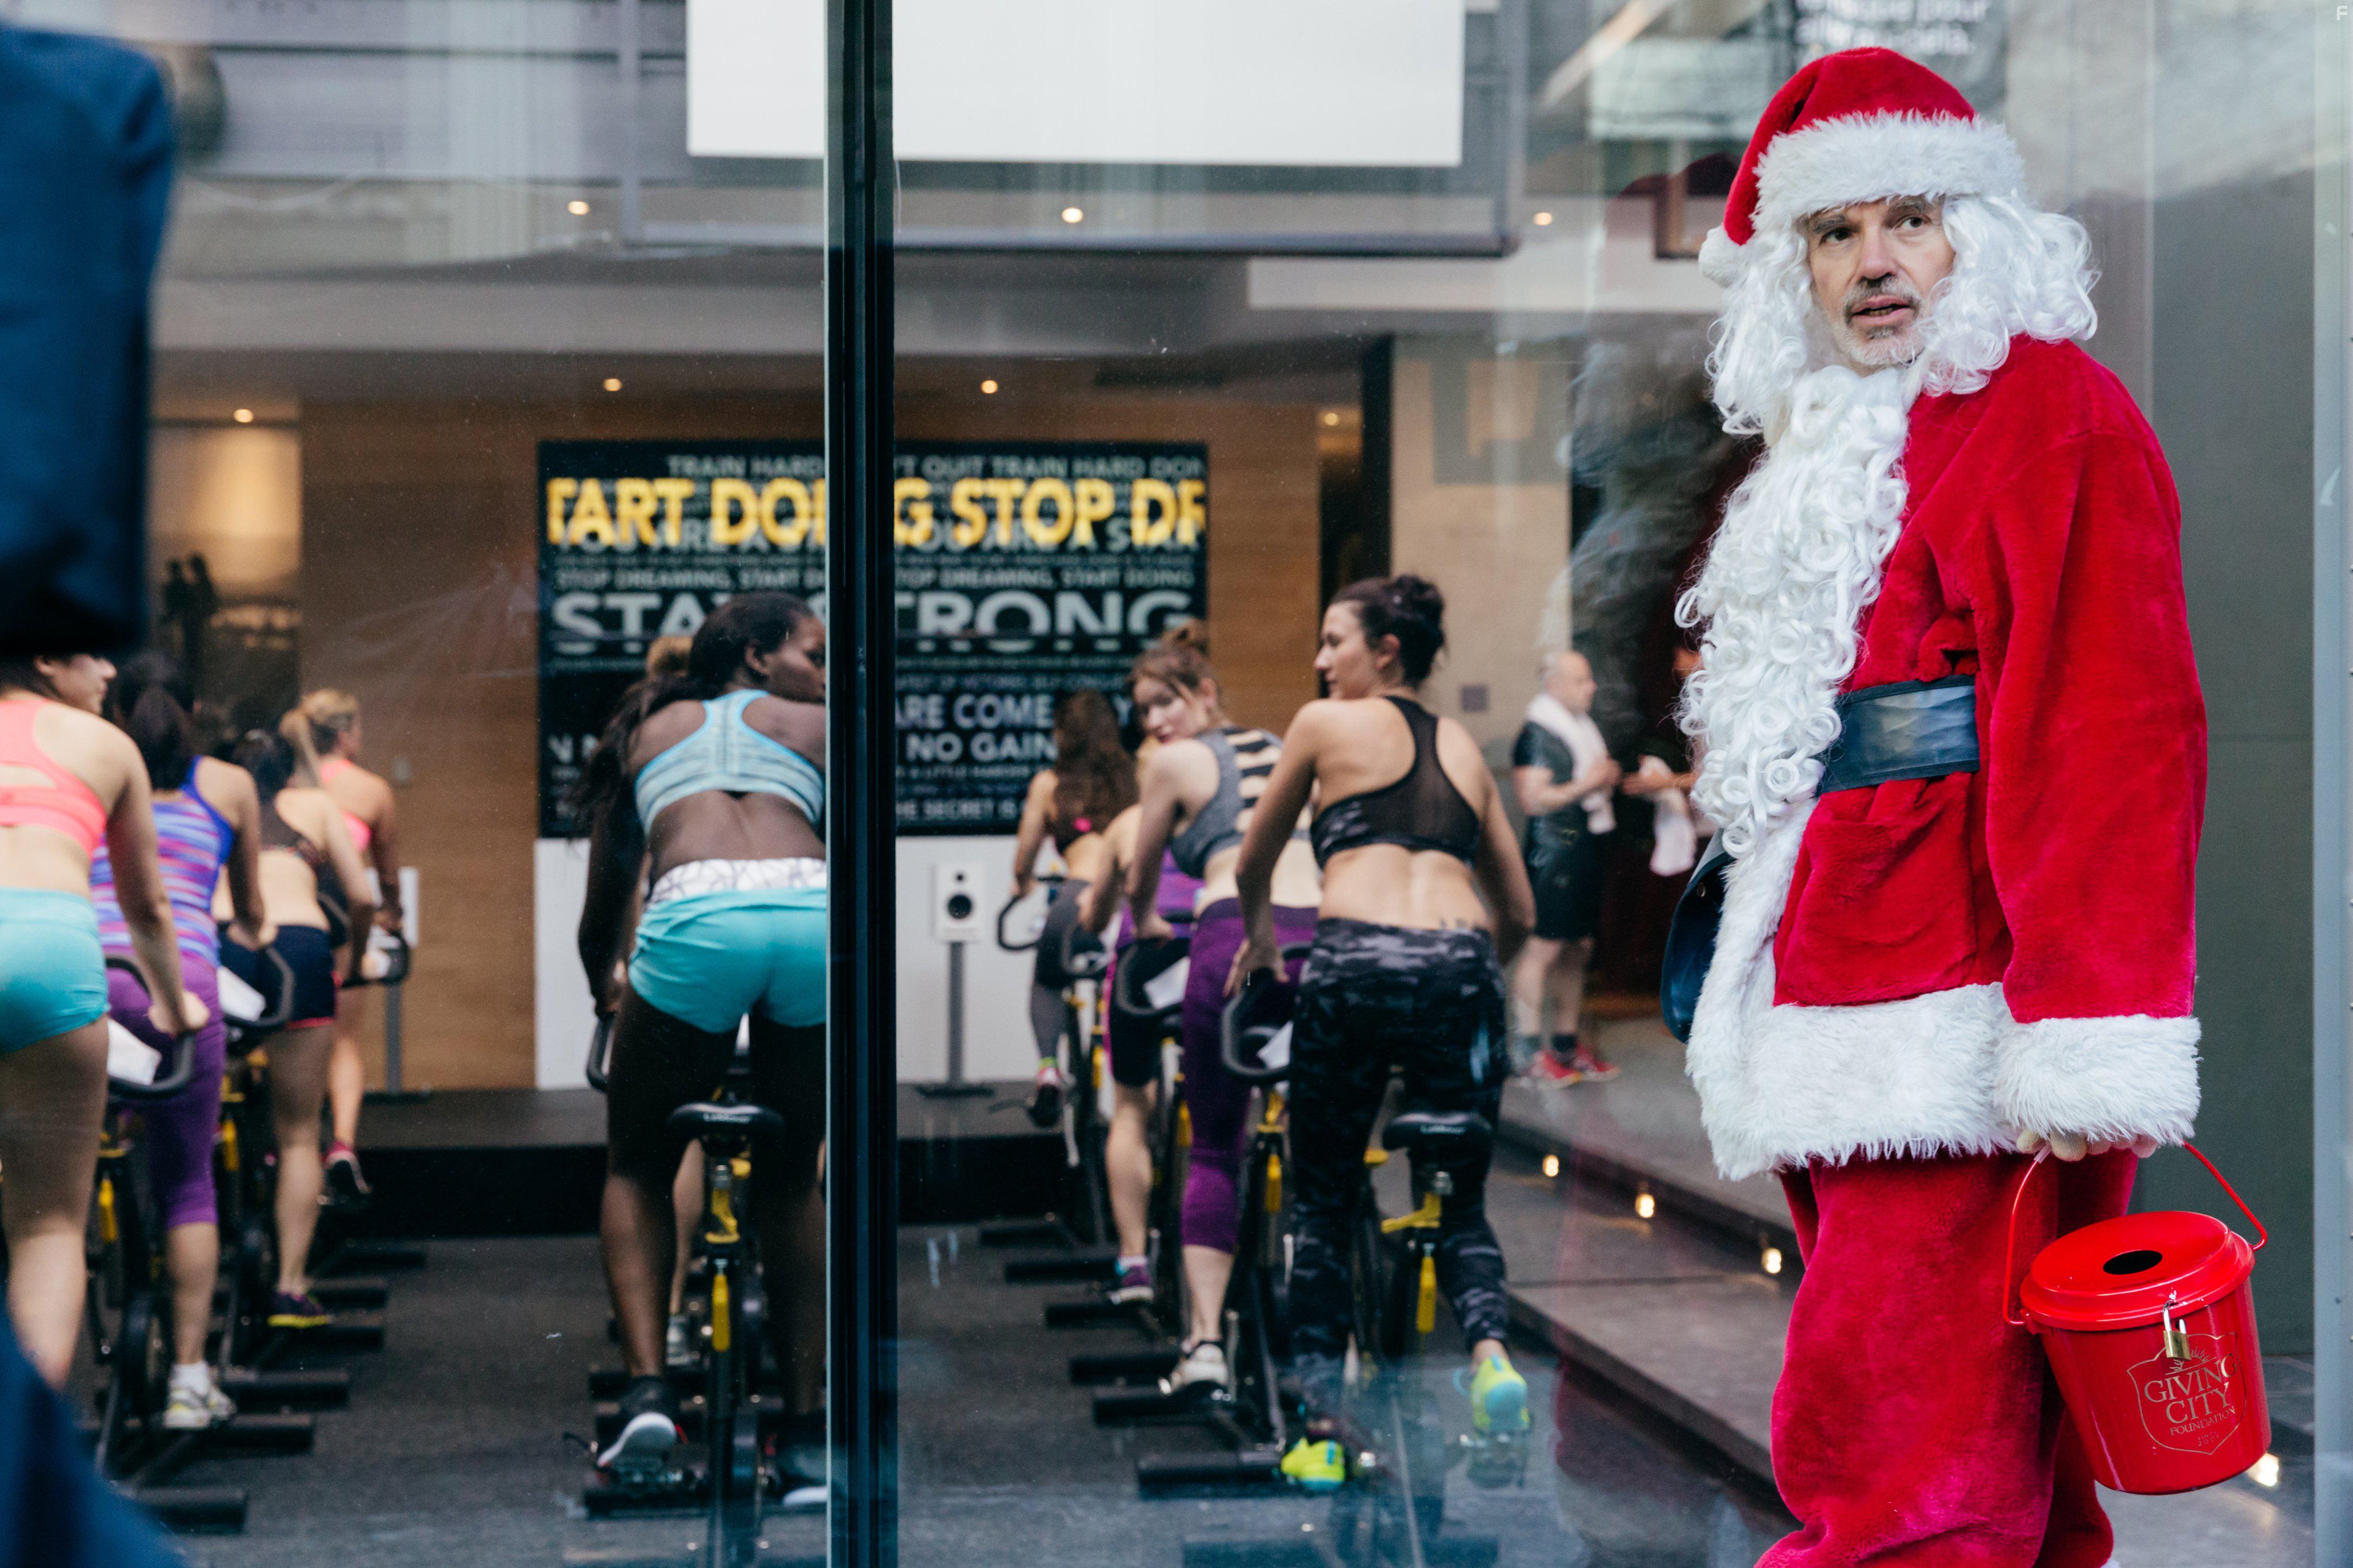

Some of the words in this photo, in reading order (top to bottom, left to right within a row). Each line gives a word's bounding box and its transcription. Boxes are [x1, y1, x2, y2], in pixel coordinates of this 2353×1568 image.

[668, 455, 746, 476] TRAIN
[921, 455, 984, 478] QUIT
[992, 455, 1067, 478] TRAIN
[1073, 456, 1145, 478] HARD
[950, 477, 1115, 546] STOP
[551, 590, 732, 654] STA
[954, 693, 1055, 729] COME
[906, 732, 963, 762] NO
[970, 732, 1060, 762] GAIN
[921, 798, 996, 819] SECRET
[2144, 1353, 2237, 1403] GIVING
[2166, 1381, 2229, 1424] CITY
[2170, 1405, 2236, 1436] FOUNDATION
